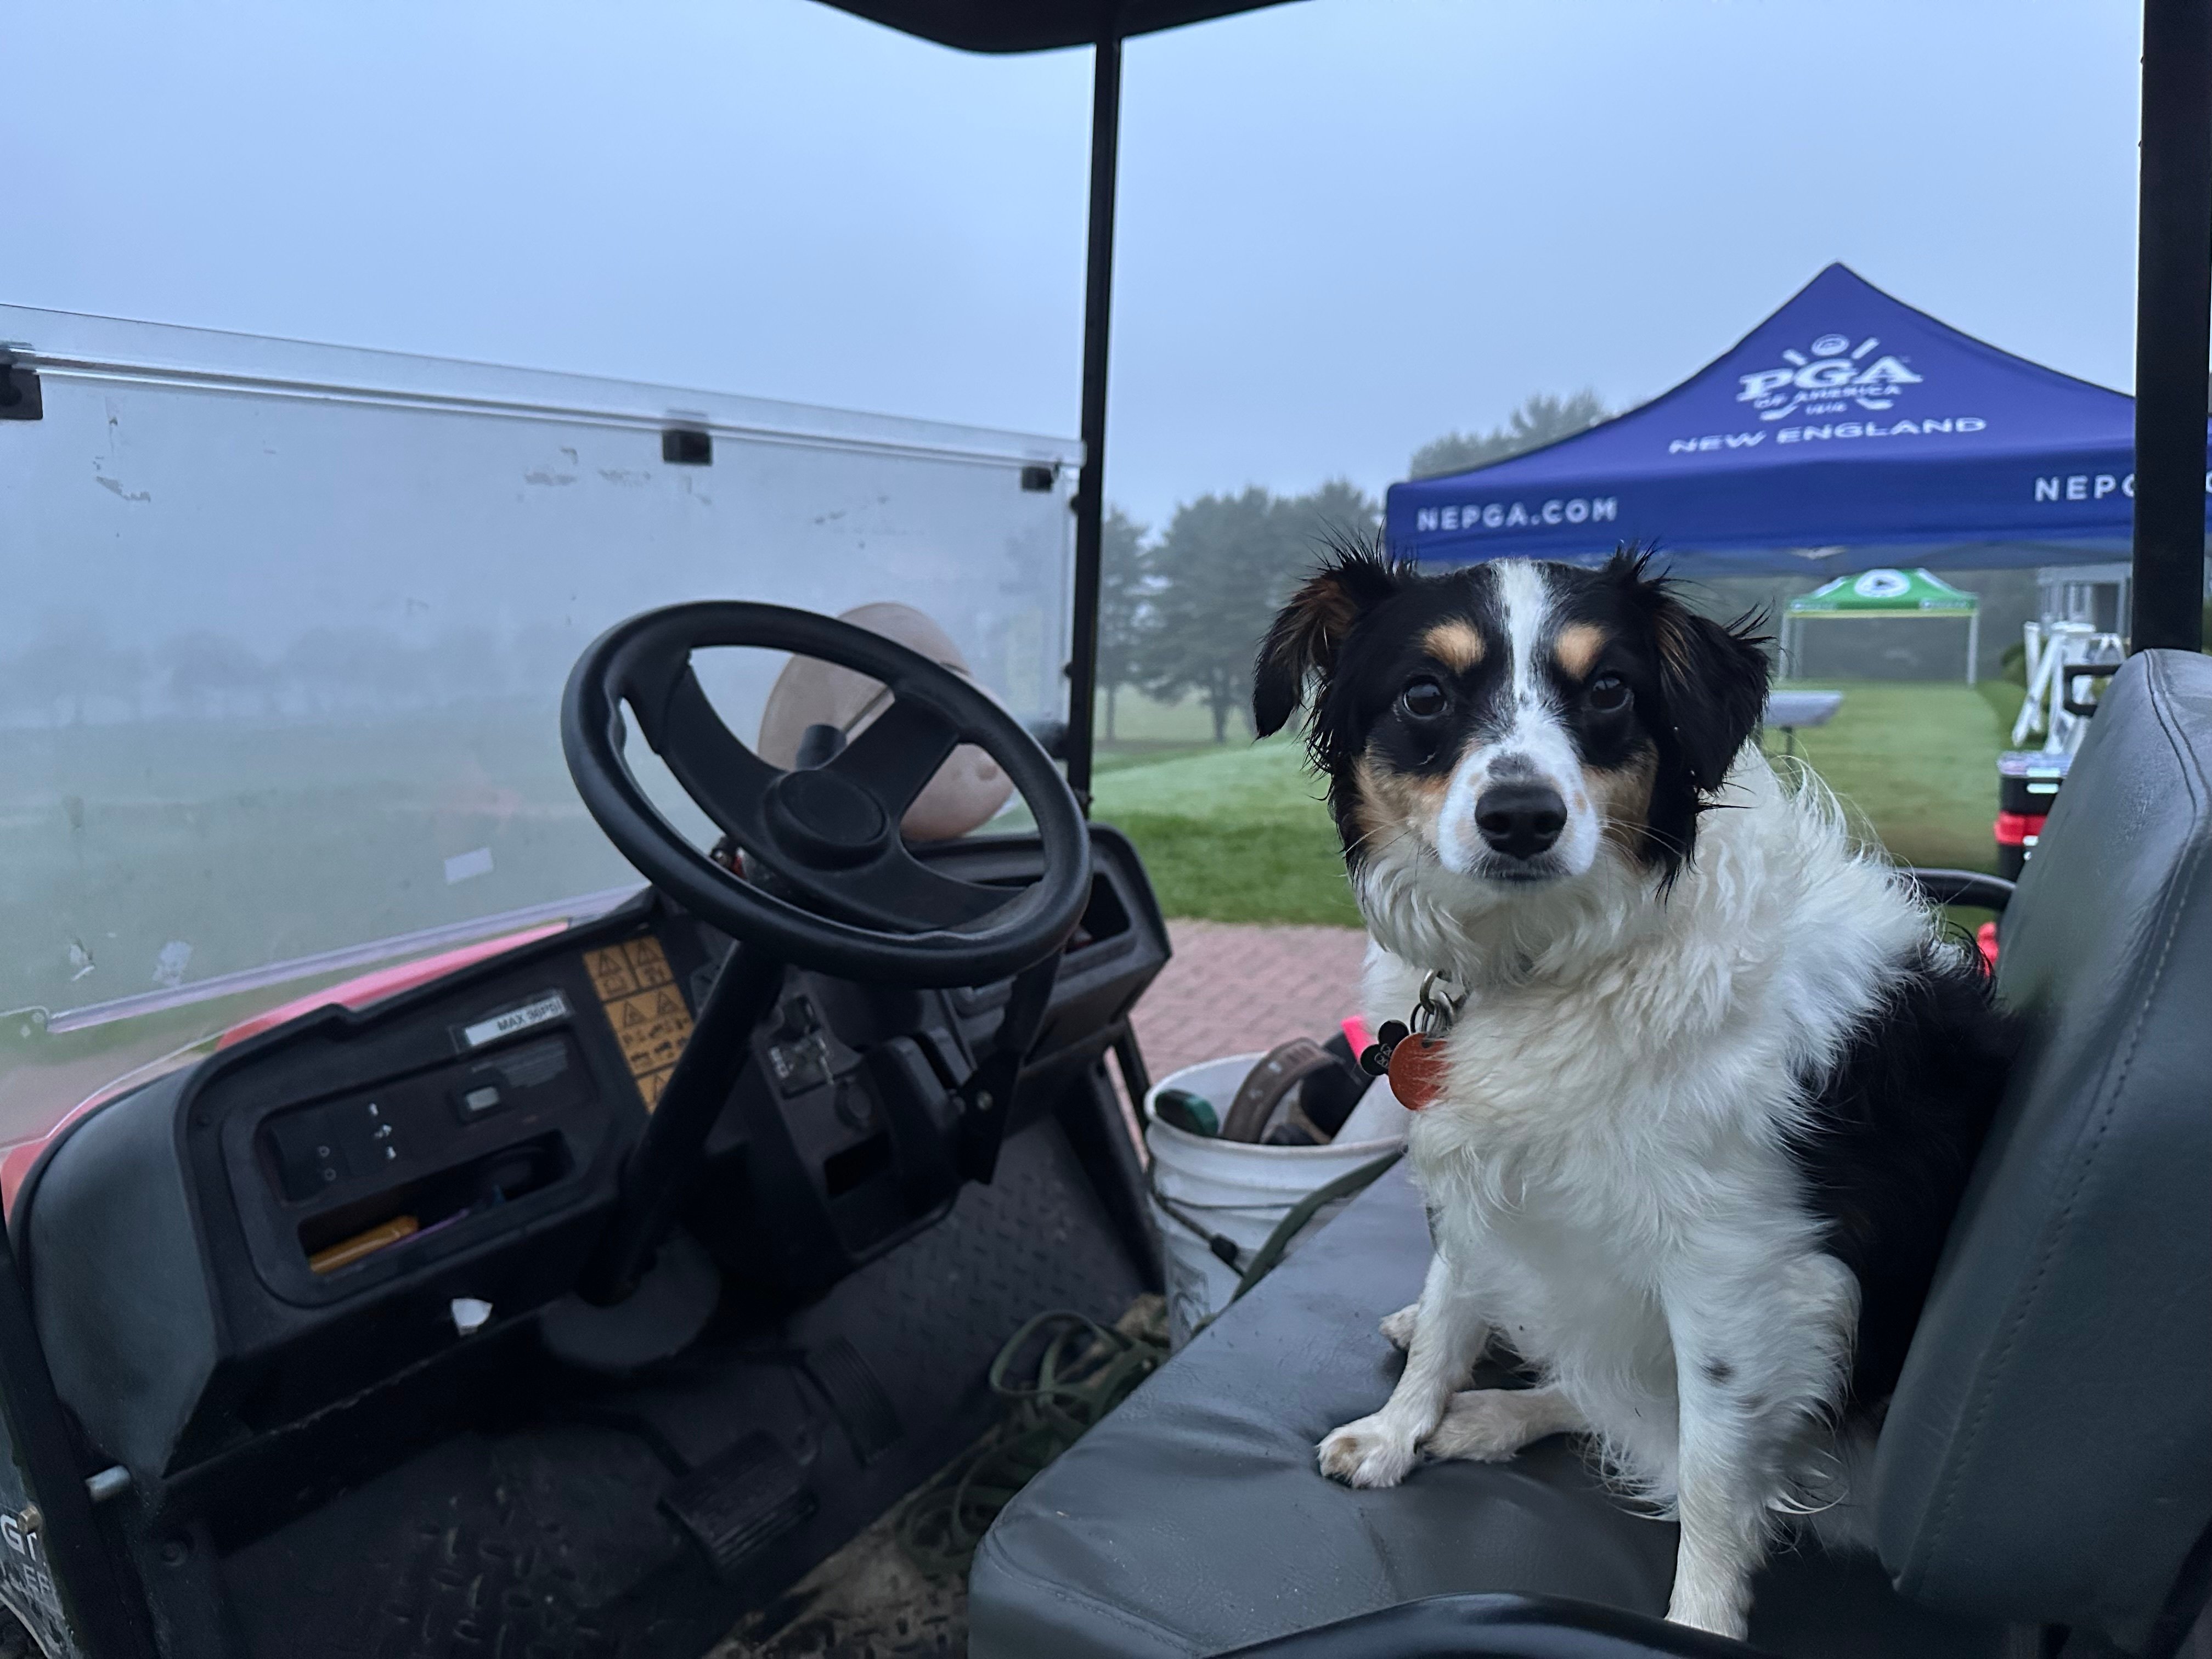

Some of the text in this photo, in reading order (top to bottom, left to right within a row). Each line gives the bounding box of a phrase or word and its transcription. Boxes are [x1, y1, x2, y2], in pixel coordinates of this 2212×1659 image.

[1736, 356, 1924, 402] PGA
[1668, 417, 1986, 454] NEW ENGLAND
[1417, 496, 1618, 532] NEPGA.COM
[496, 1014, 527, 1031] MAX
